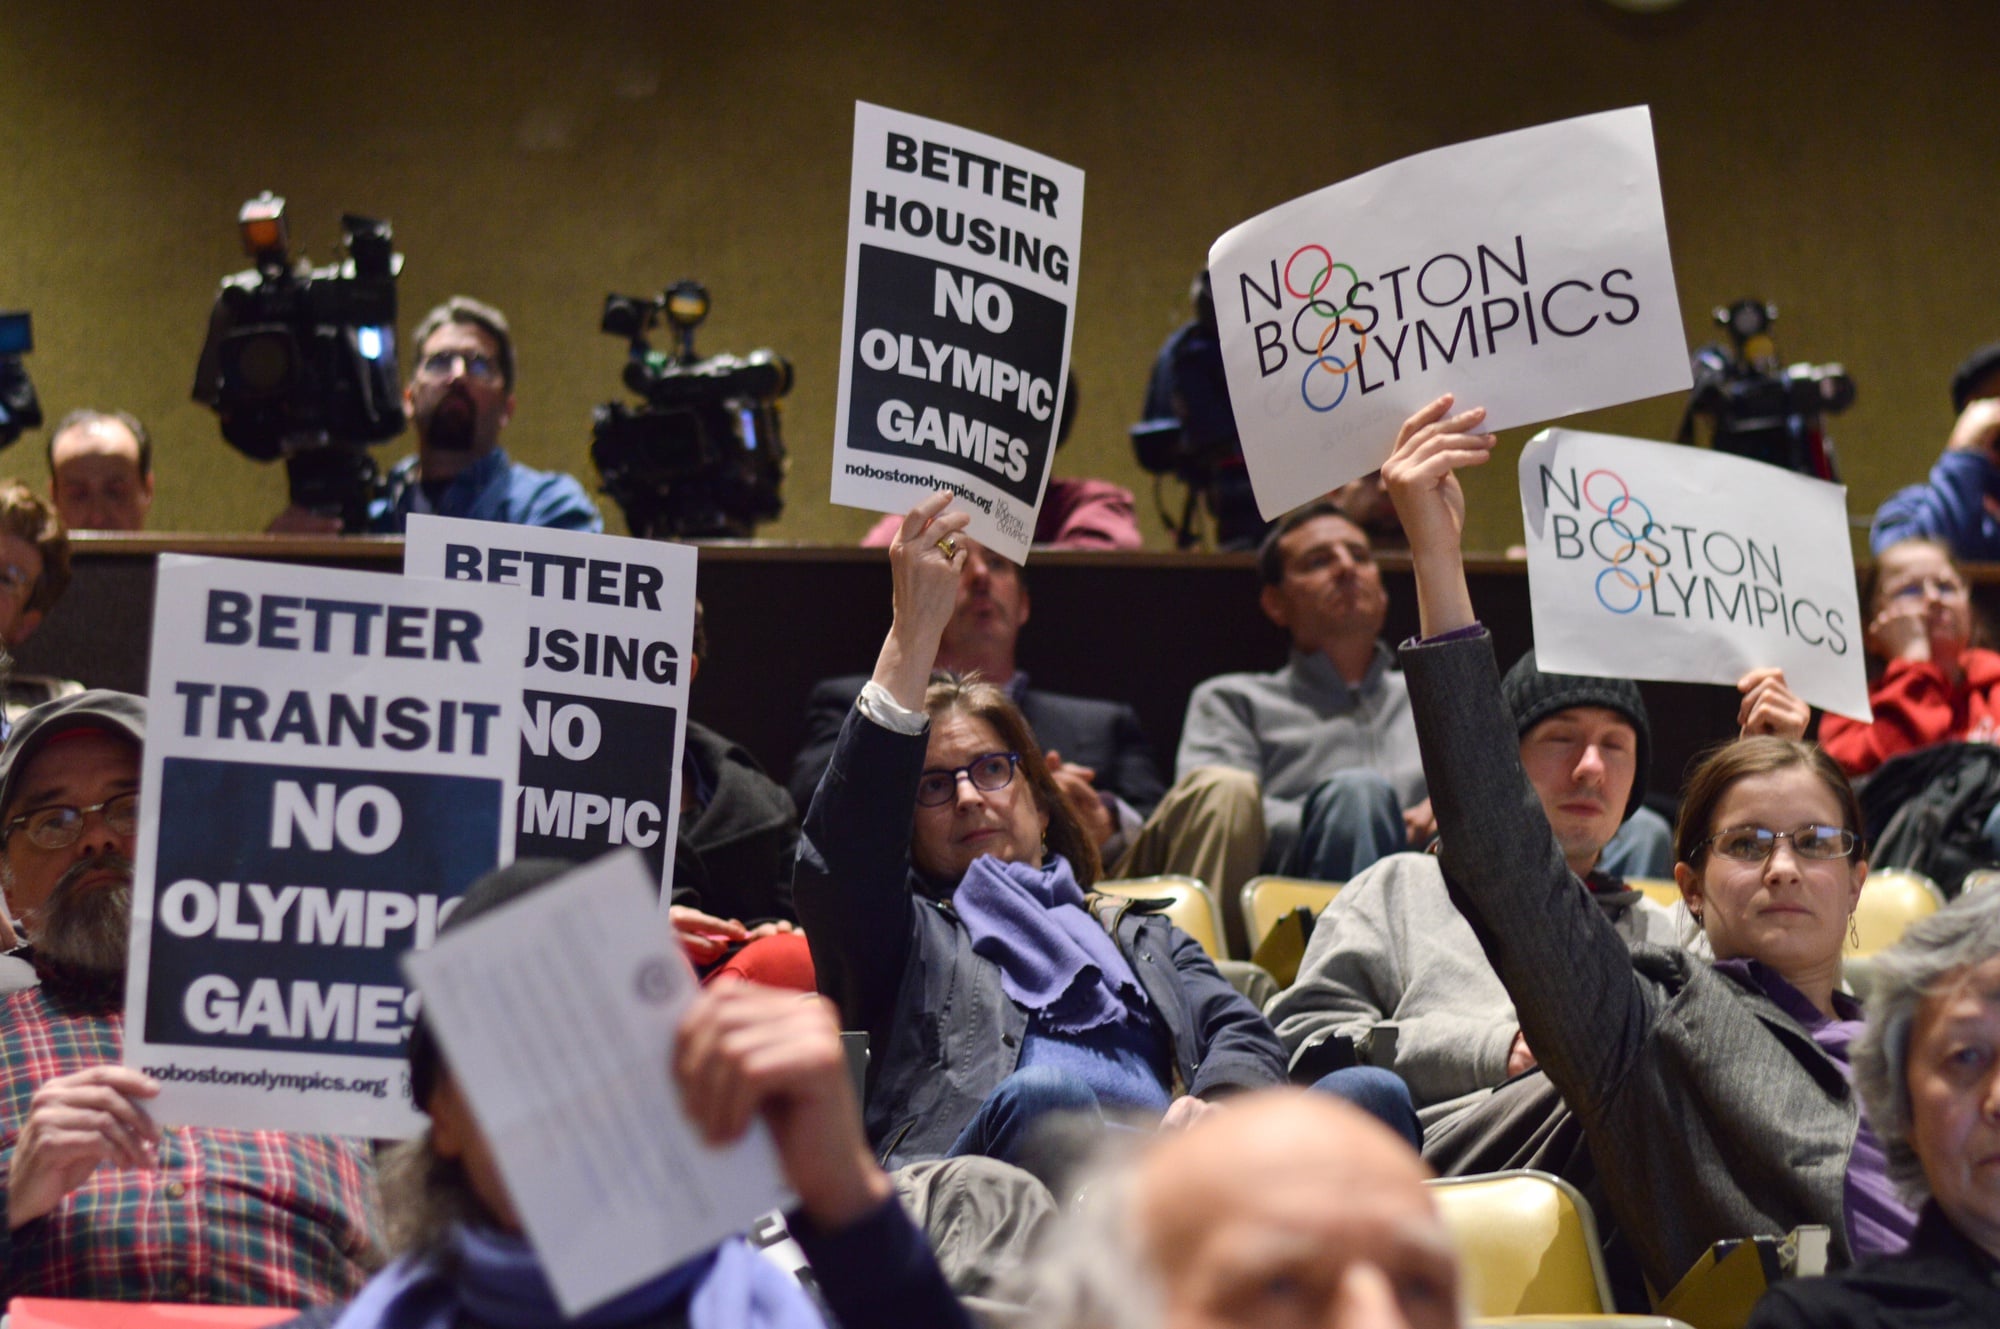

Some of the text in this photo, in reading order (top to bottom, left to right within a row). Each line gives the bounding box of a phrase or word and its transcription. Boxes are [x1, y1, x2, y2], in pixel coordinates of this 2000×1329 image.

[886, 131, 1059, 219] BETTER
[864, 190, 1070, 286] HOUSING
[934, 268, 1014, 334] NO
[1239, 244, 1332, 324] NO
[1254, 235, 1528, 378] BOSTON
[860, 328, 1053, 421] OLYMPIC
[1302, 268, 1640, 412] OLYMPICS
[876, 399, 1029, 482] GAMES
[845, 463, 993, 514] nobostonolympics.org
[1539, 464, 1629, 514] NO
[445, 543, 664, 611] BETTER
[1552, 514, 1782, 588] BOSTON
[205, 589, 483, 663] BETTER
[1595, 567, 1848, 655] OLYMPICS
[523, 626, 678, 686] SING
[175, 681, 502, 756] TRANSIT
[520, 700, 601, 761] NO
[270, 780, 402, 854] NO
[517, 785, 661, 848] MPIC
[141, 1064, 388, 1097] nobostonolympics.org
